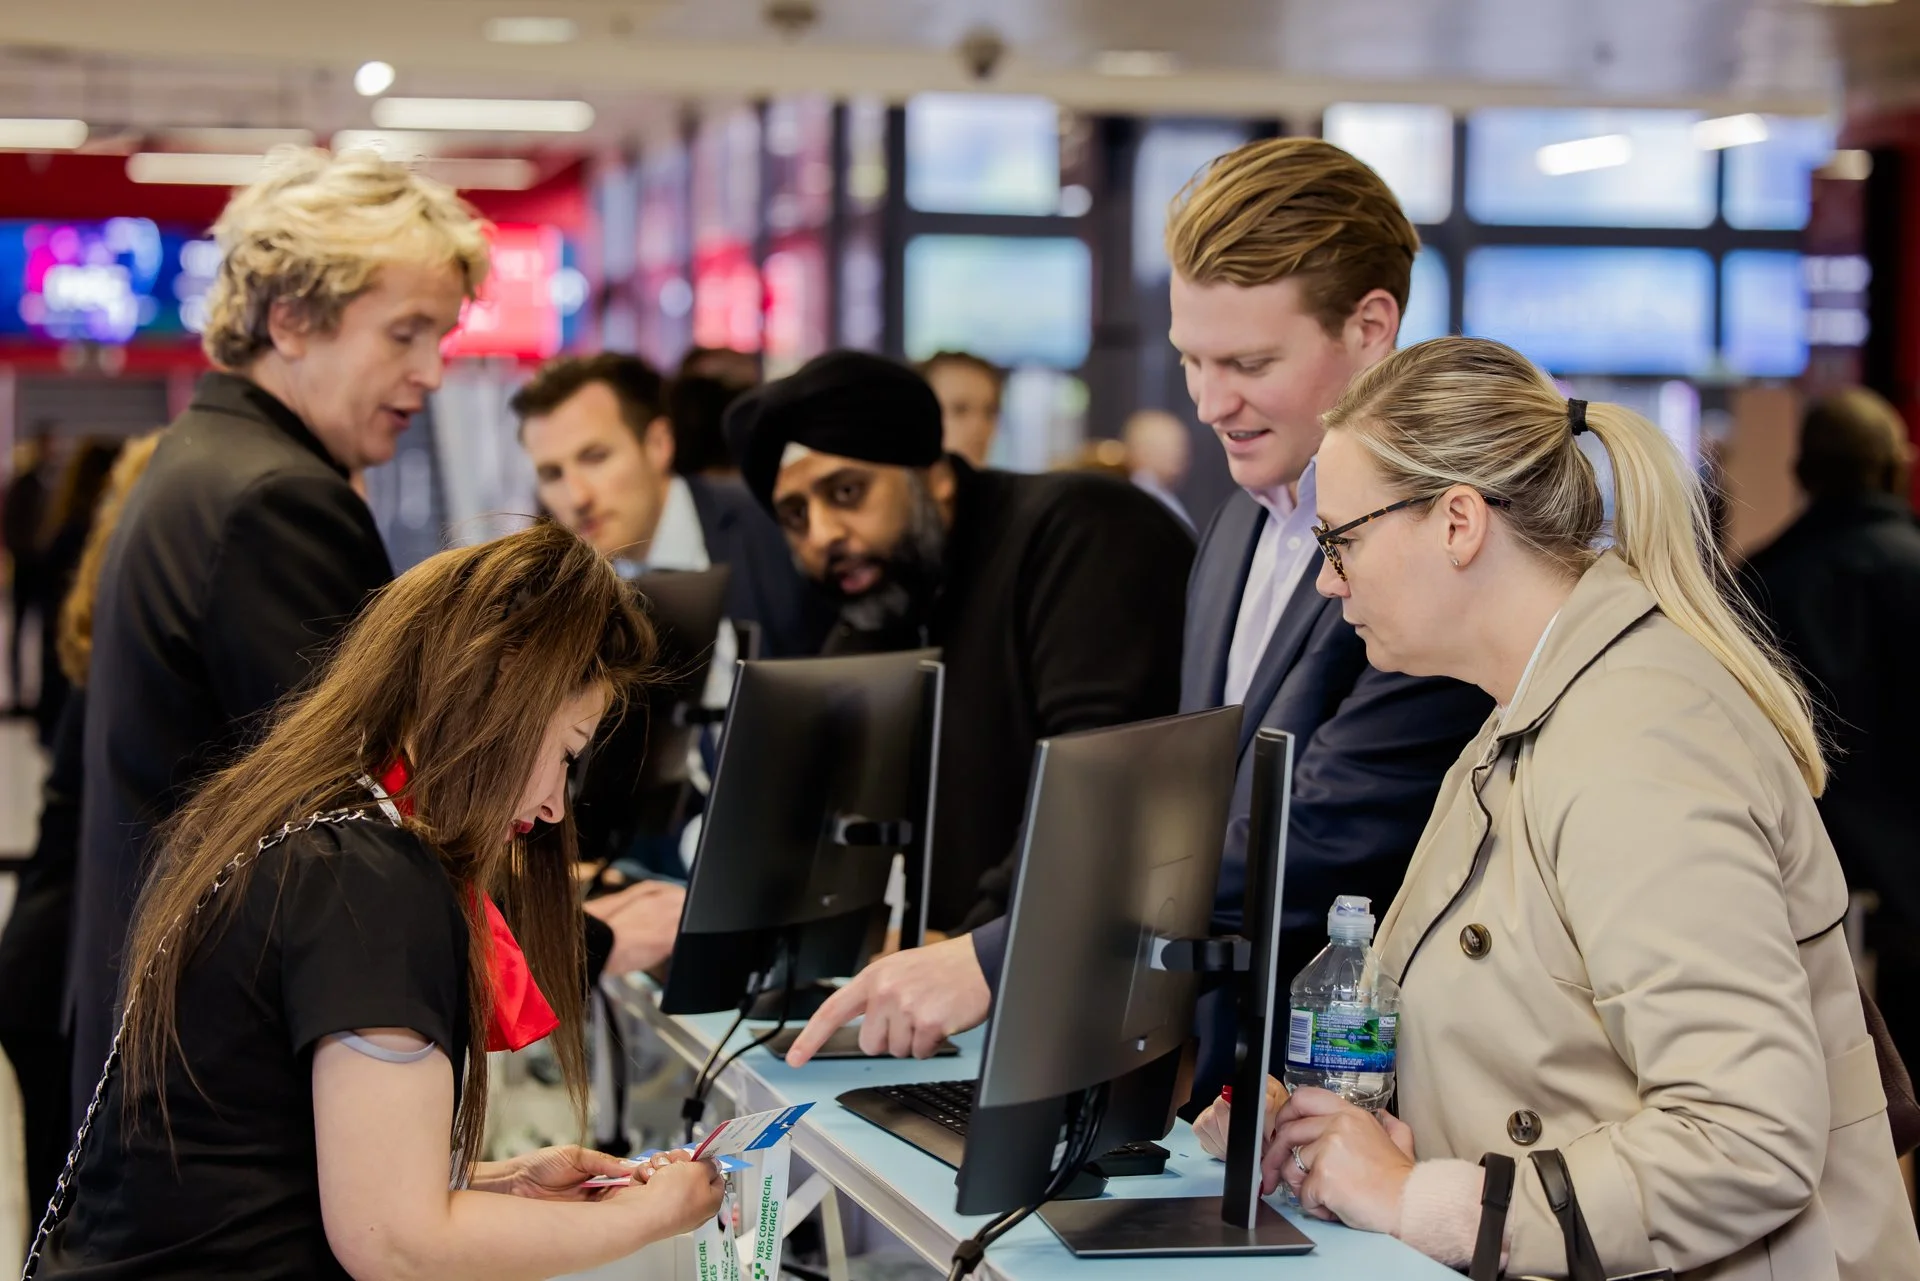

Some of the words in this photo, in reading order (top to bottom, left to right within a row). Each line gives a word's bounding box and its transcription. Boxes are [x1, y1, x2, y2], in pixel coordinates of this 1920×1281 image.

[759, 1174, 773, 1238] COMMERCIAL
[765, 1200, 778, 1261] MORTGAGES
[756, 1240, 765, 1259] YBS
